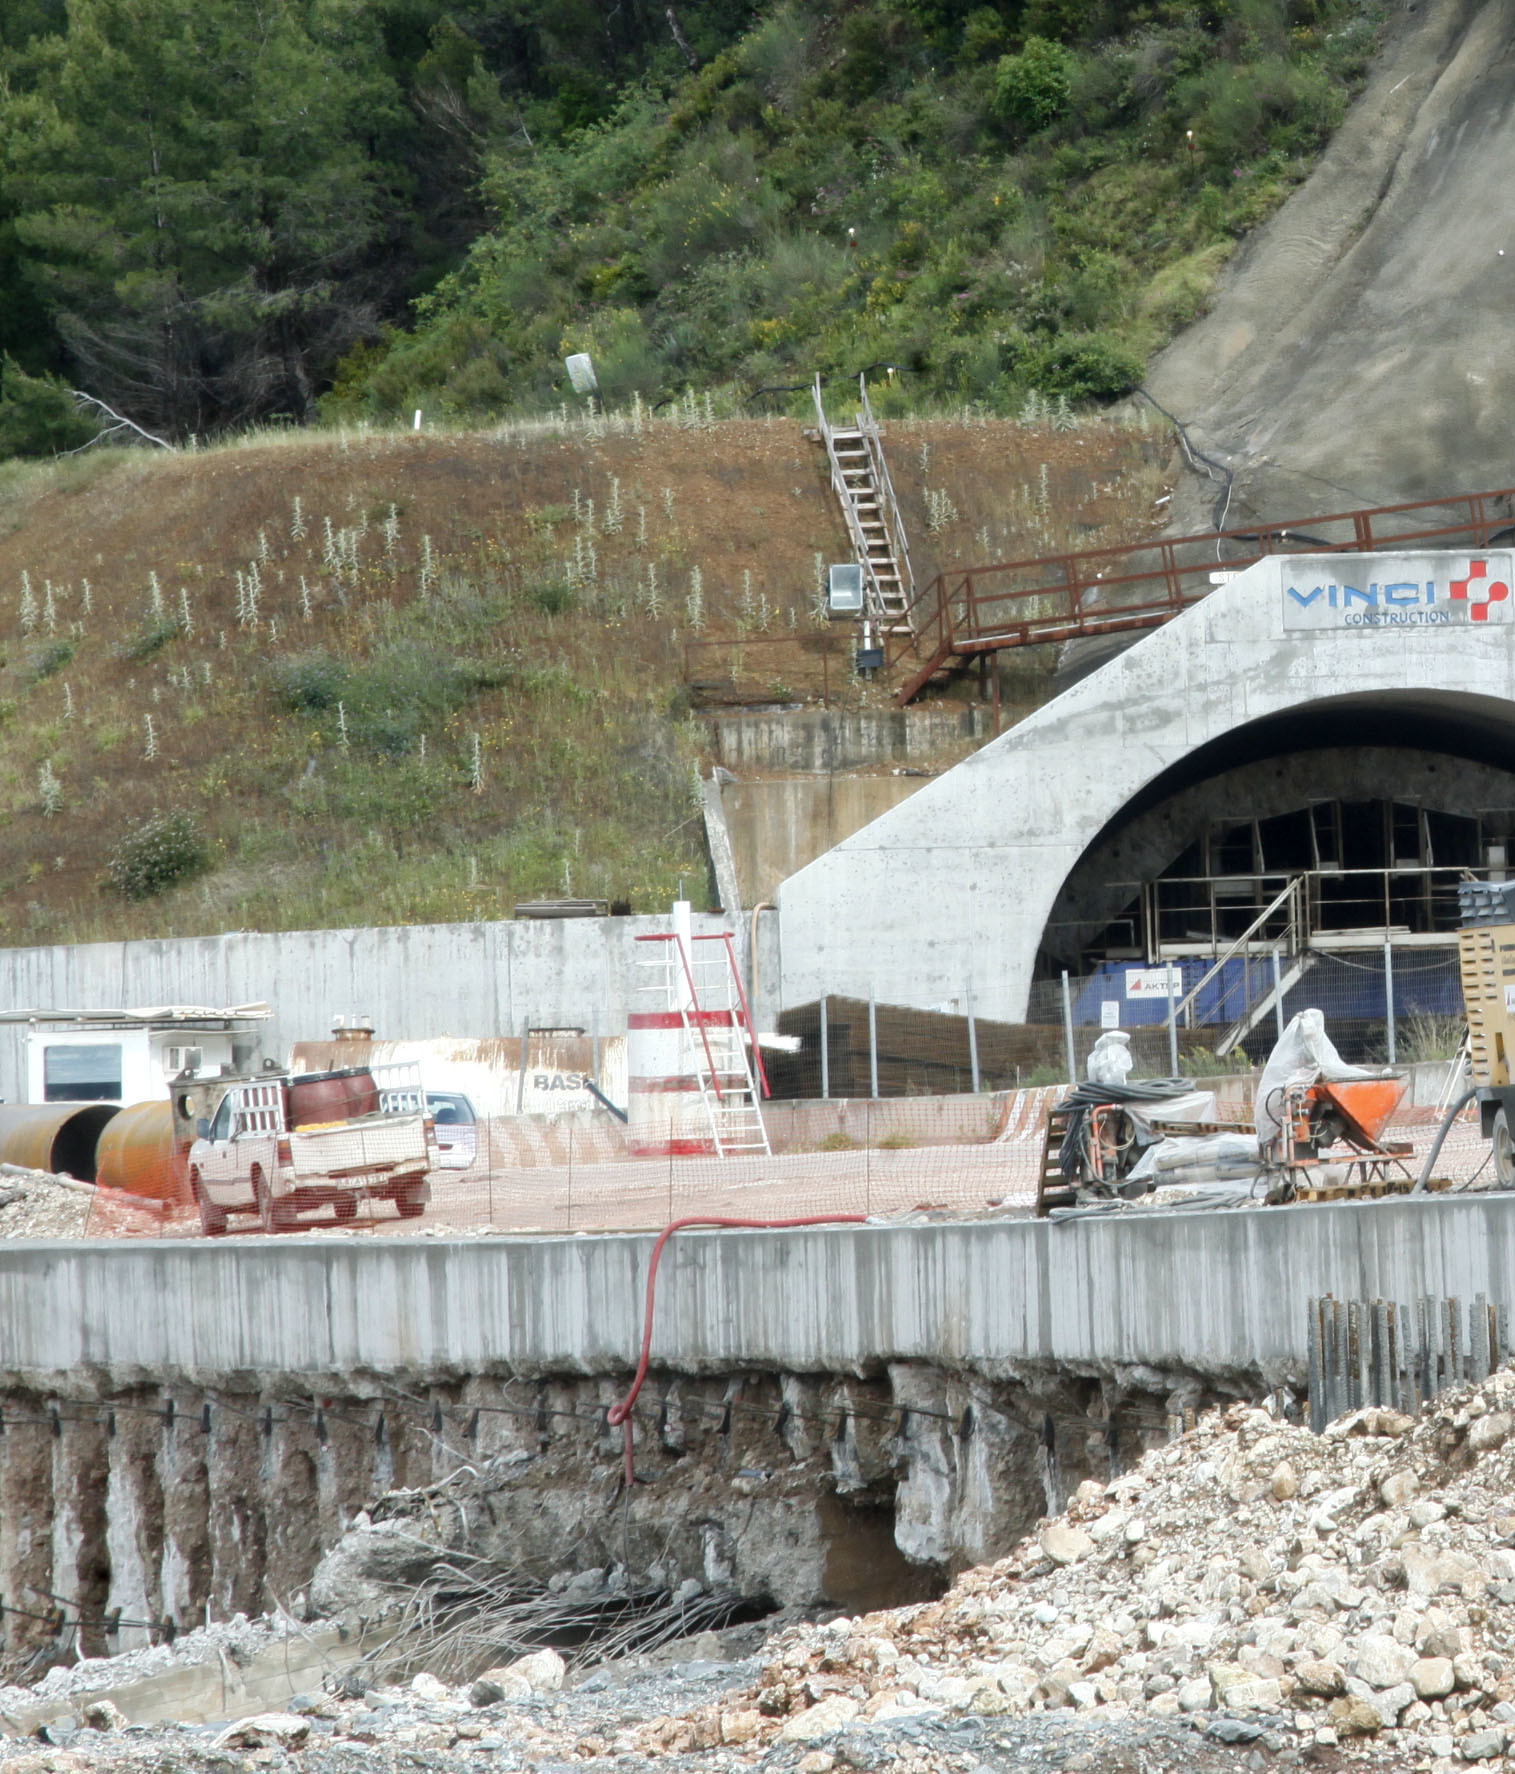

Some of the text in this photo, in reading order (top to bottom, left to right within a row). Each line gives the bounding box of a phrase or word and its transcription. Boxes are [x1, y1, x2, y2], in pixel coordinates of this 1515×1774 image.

[1287, 581, 1435, 608] VINCI
[1344, 611, 1449, 625] CONSTRUCTION
[1144, 982, 1180, 991] ΑΚΤΡ
[534, 1074, 589, 1092] BAS
